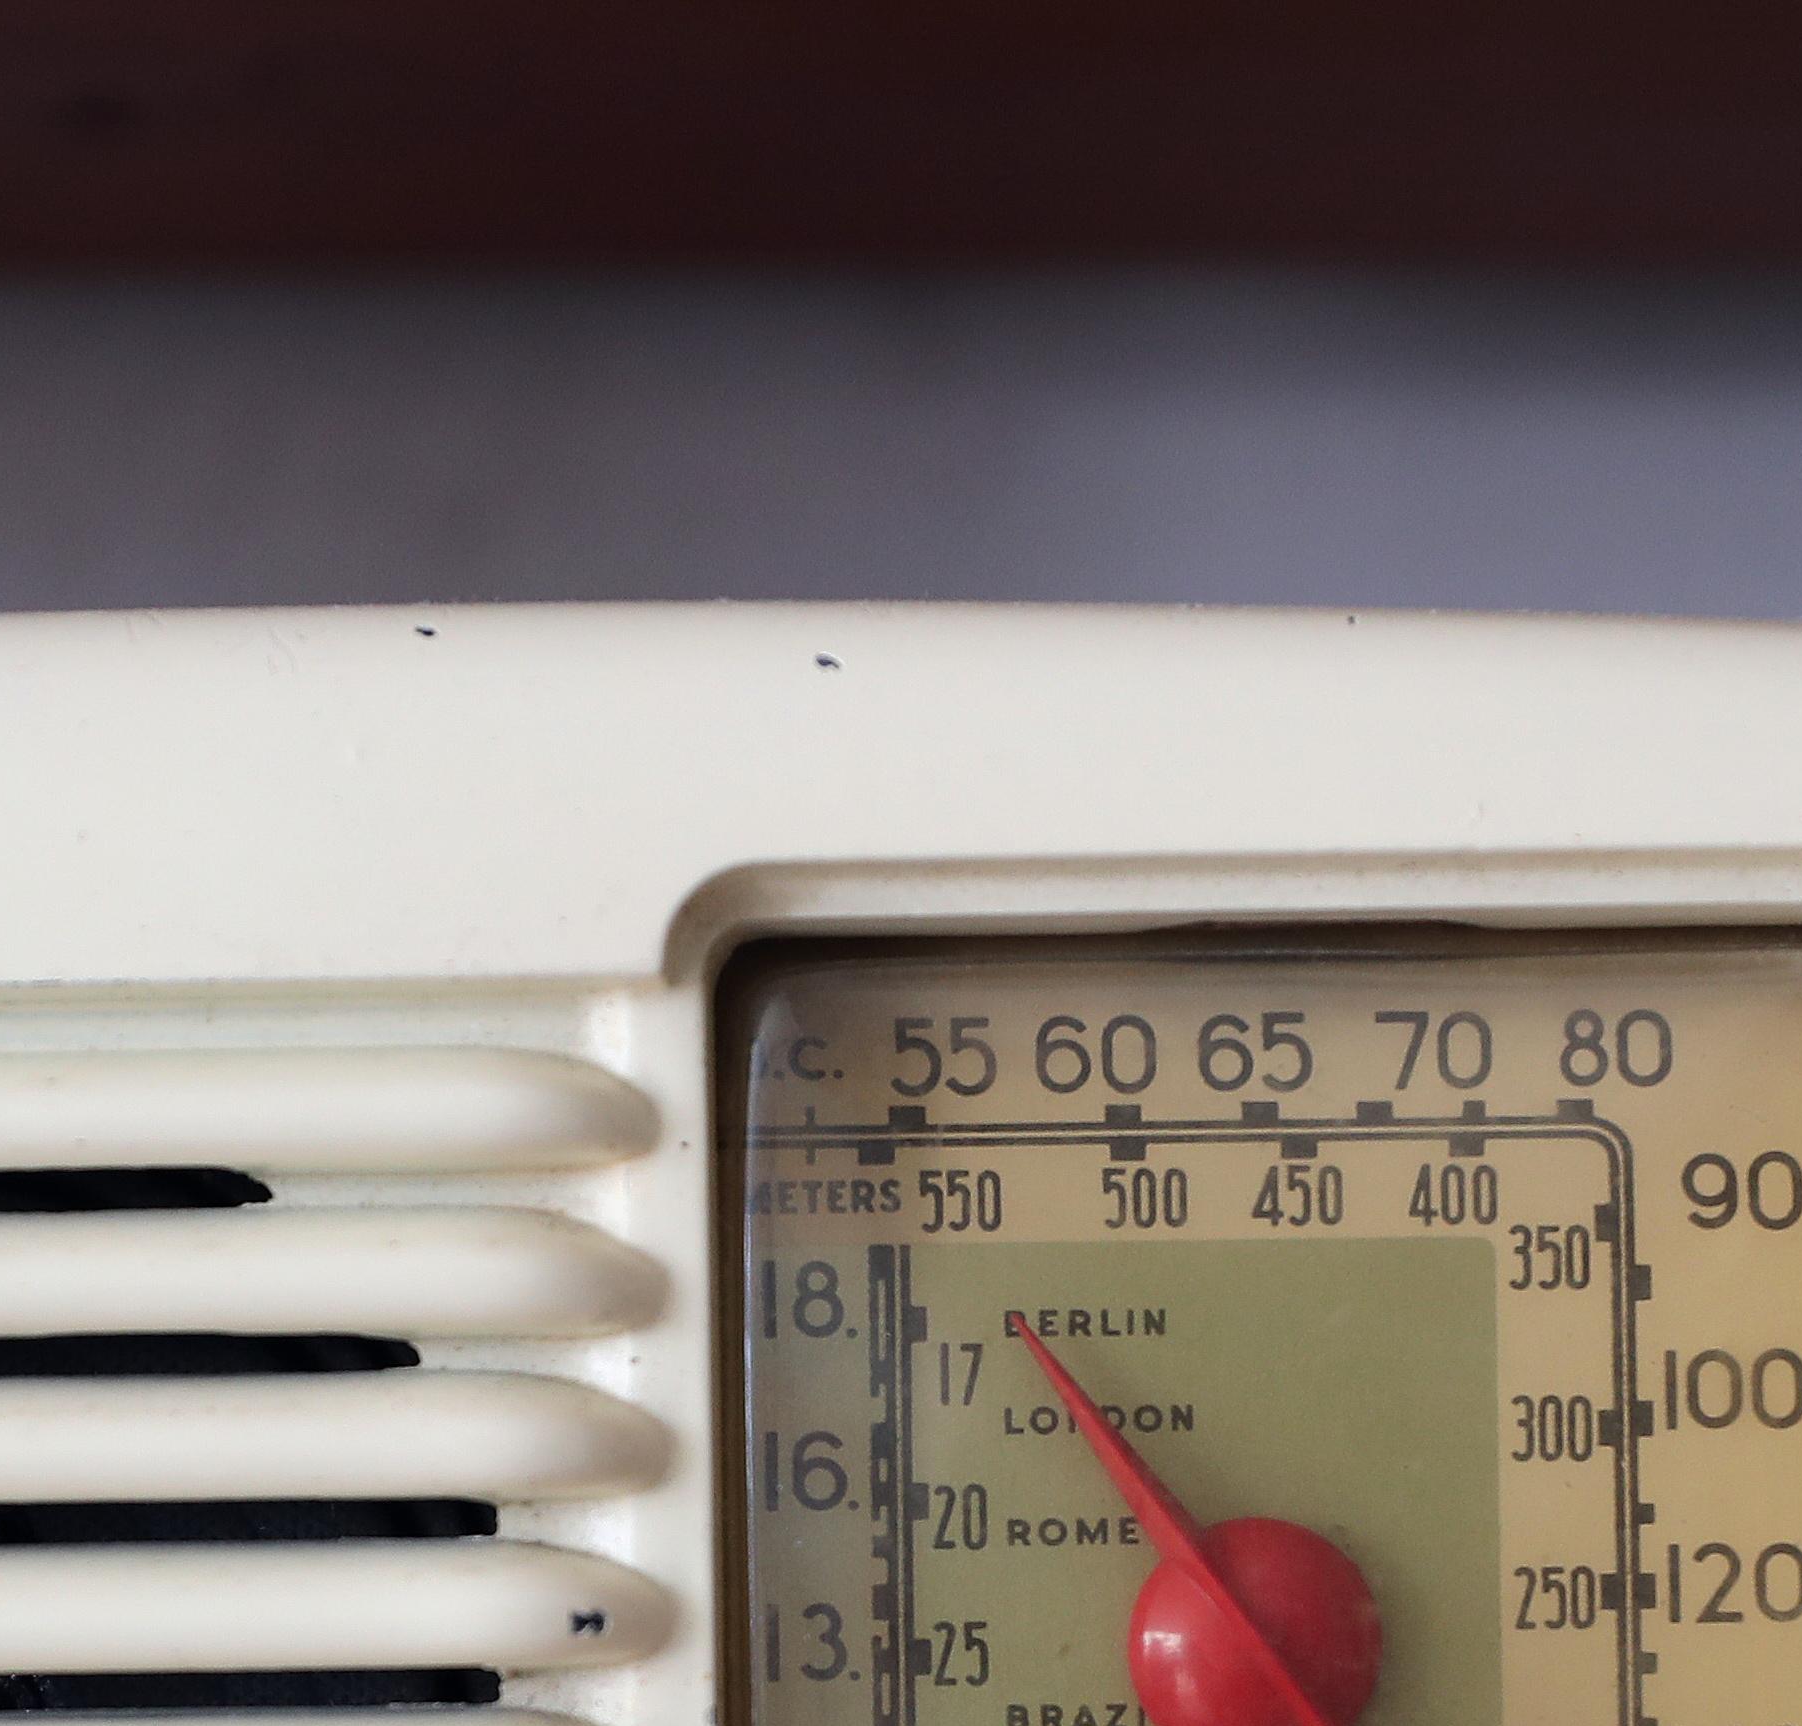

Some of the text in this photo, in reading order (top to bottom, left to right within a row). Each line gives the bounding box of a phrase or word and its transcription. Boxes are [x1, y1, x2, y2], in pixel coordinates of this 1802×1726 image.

[758, 1008, 1674, 1097] .C. 55 60 65 70 80
[918, 1169, 1002, 1233] 550
[1102, 1167, 1189, 1229] 500
[1252, 1164, 1344, 1227] 450
[1408, 1163, 1498, 1227] 400
[1508, 1225, 1591, 1291] 350
[1004, 1308, 1167, 1338] BERLIN
[939, 1342, 982, 1406] 17
[1511, 1395, 1594, 1463] 300
[932, 1483, 989, 1551] 20
[1007, 1517, 1140, 1547] ROME
[1514, 1566, 1596, 1630] 250
[933, 1621, 990, 1687] 25
